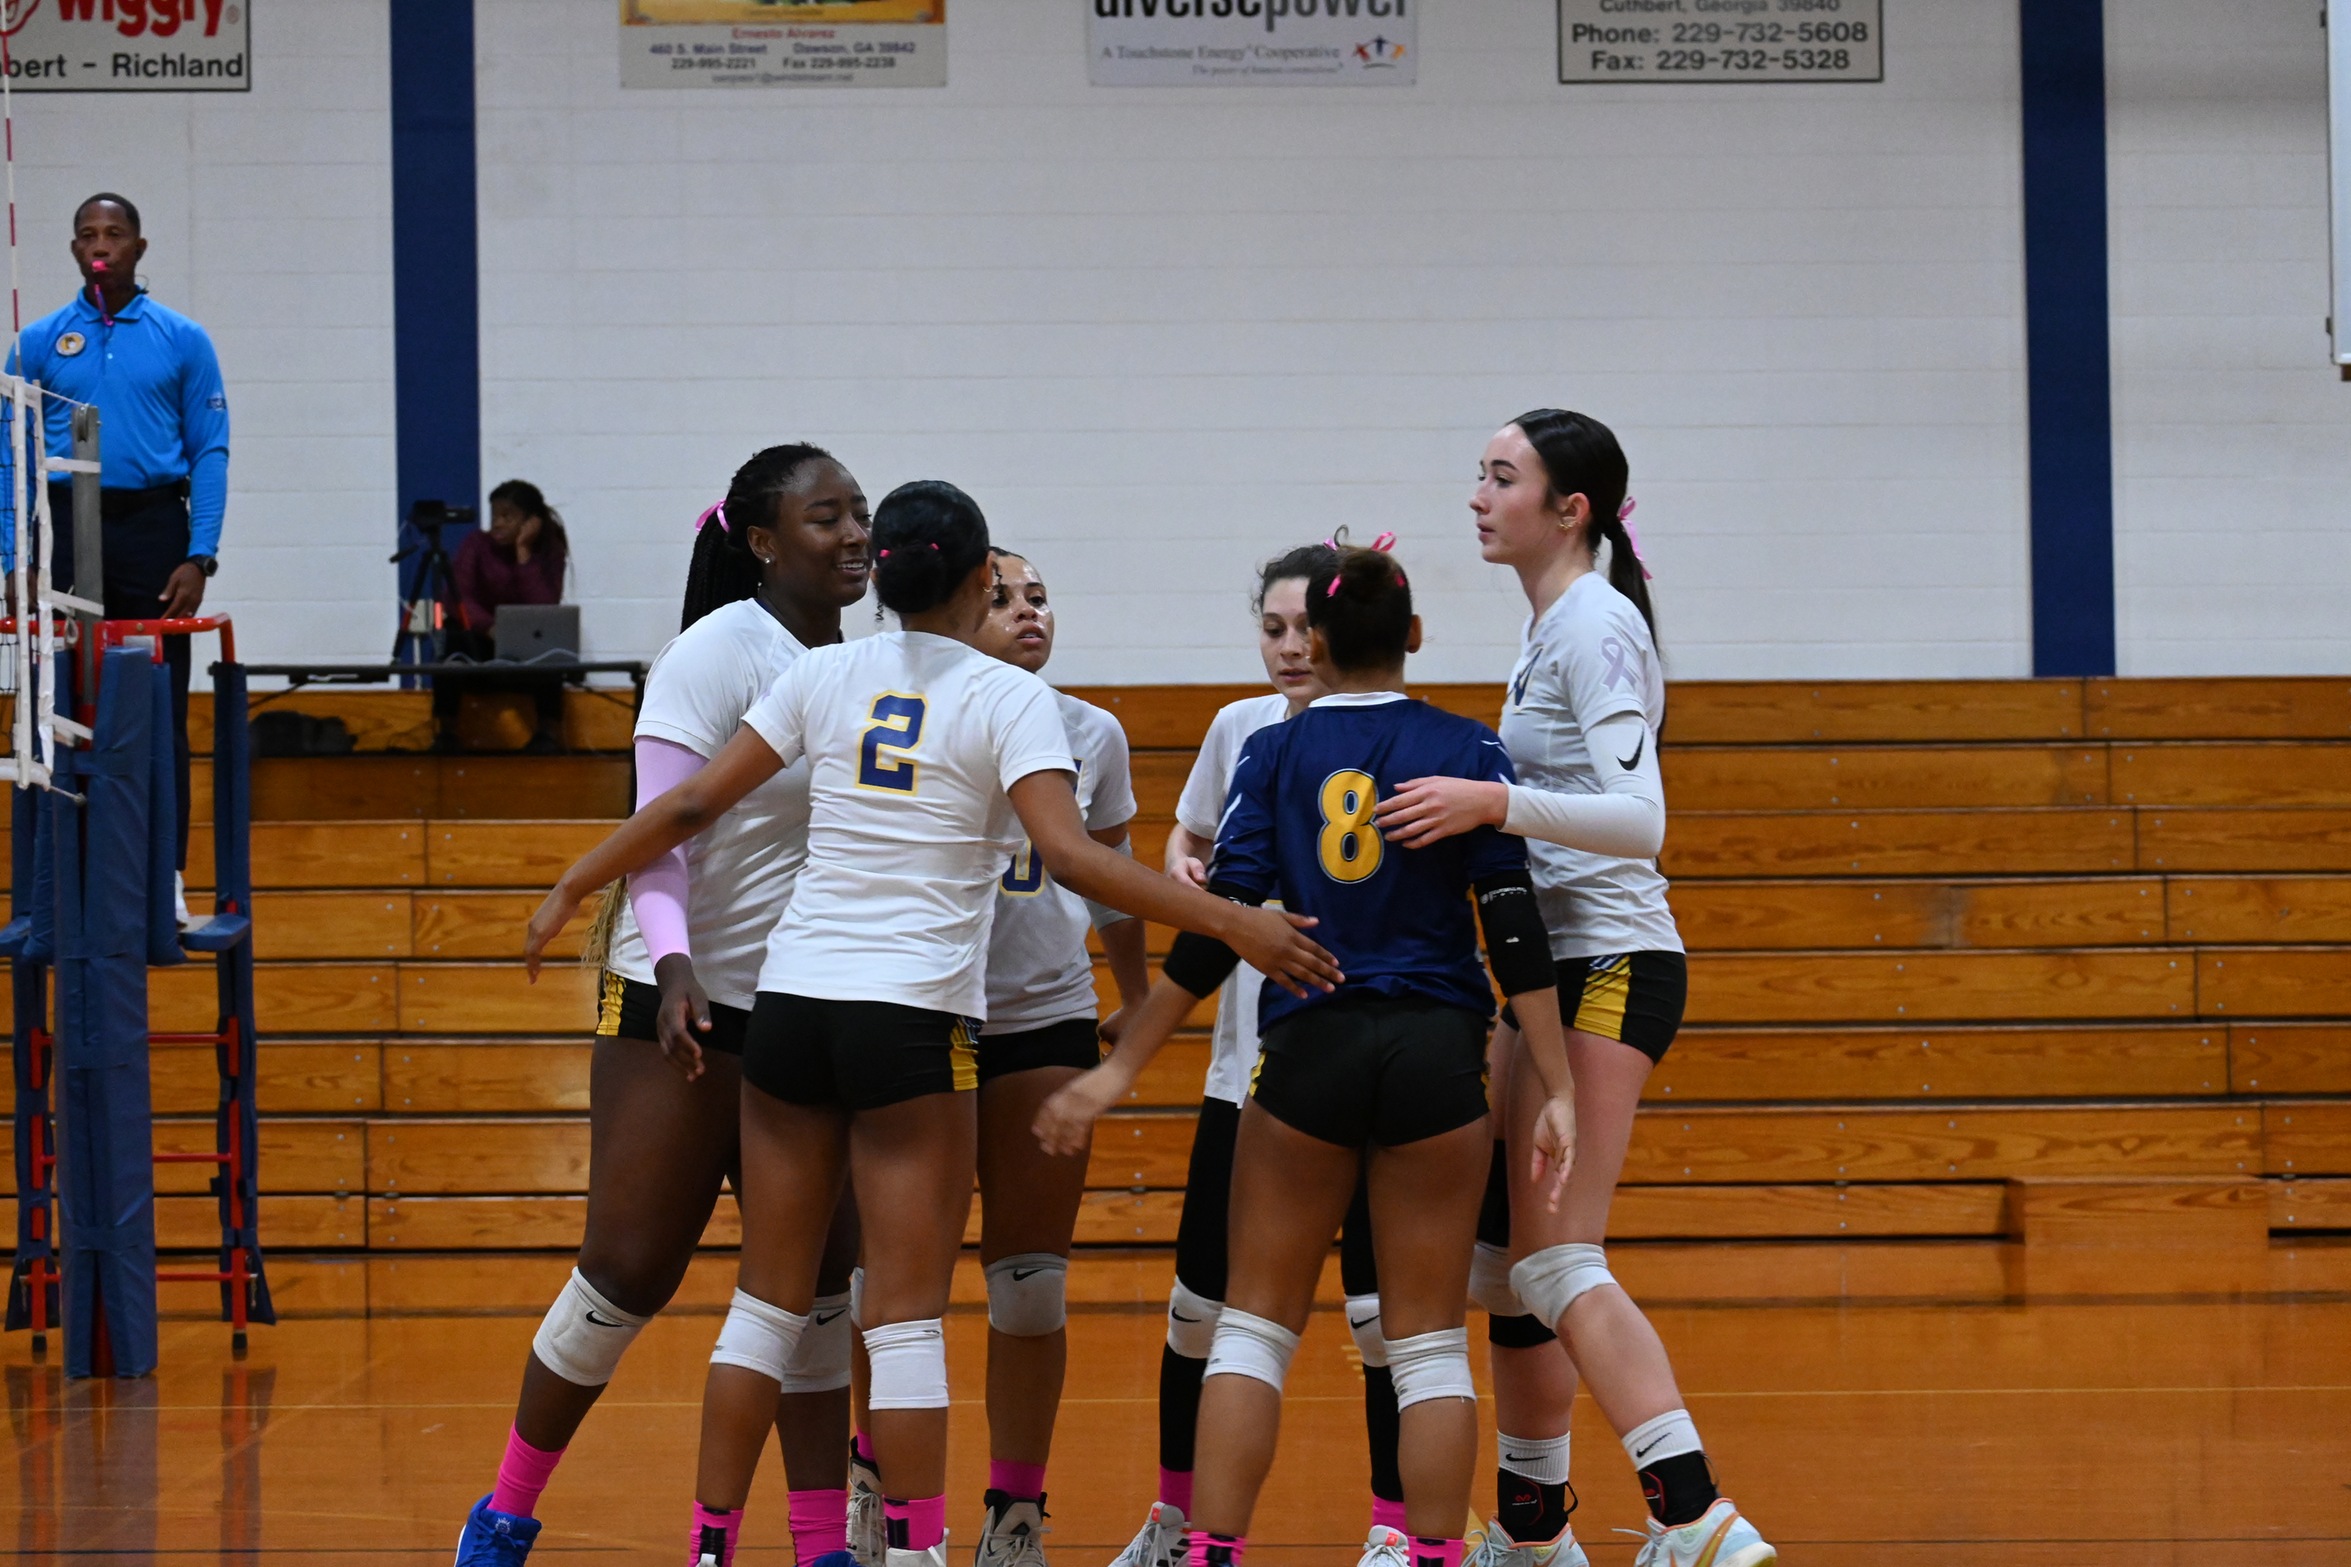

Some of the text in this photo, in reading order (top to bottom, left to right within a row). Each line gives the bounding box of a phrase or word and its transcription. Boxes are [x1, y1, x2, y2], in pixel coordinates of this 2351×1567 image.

[1572, 22, 1868, 43] Phone: 229-732-5608
[692, 43, 725, 54] Main
[729, 42, 767, 54] Street
[852, 42, 874, 54] GA
[1591, 49, 1850, 71] Fax: 229-732-5328
[112, 52, 244, 78] Richland
[855, 689, 929, 797] 2
[1317, 768, 1385, 885] 8
